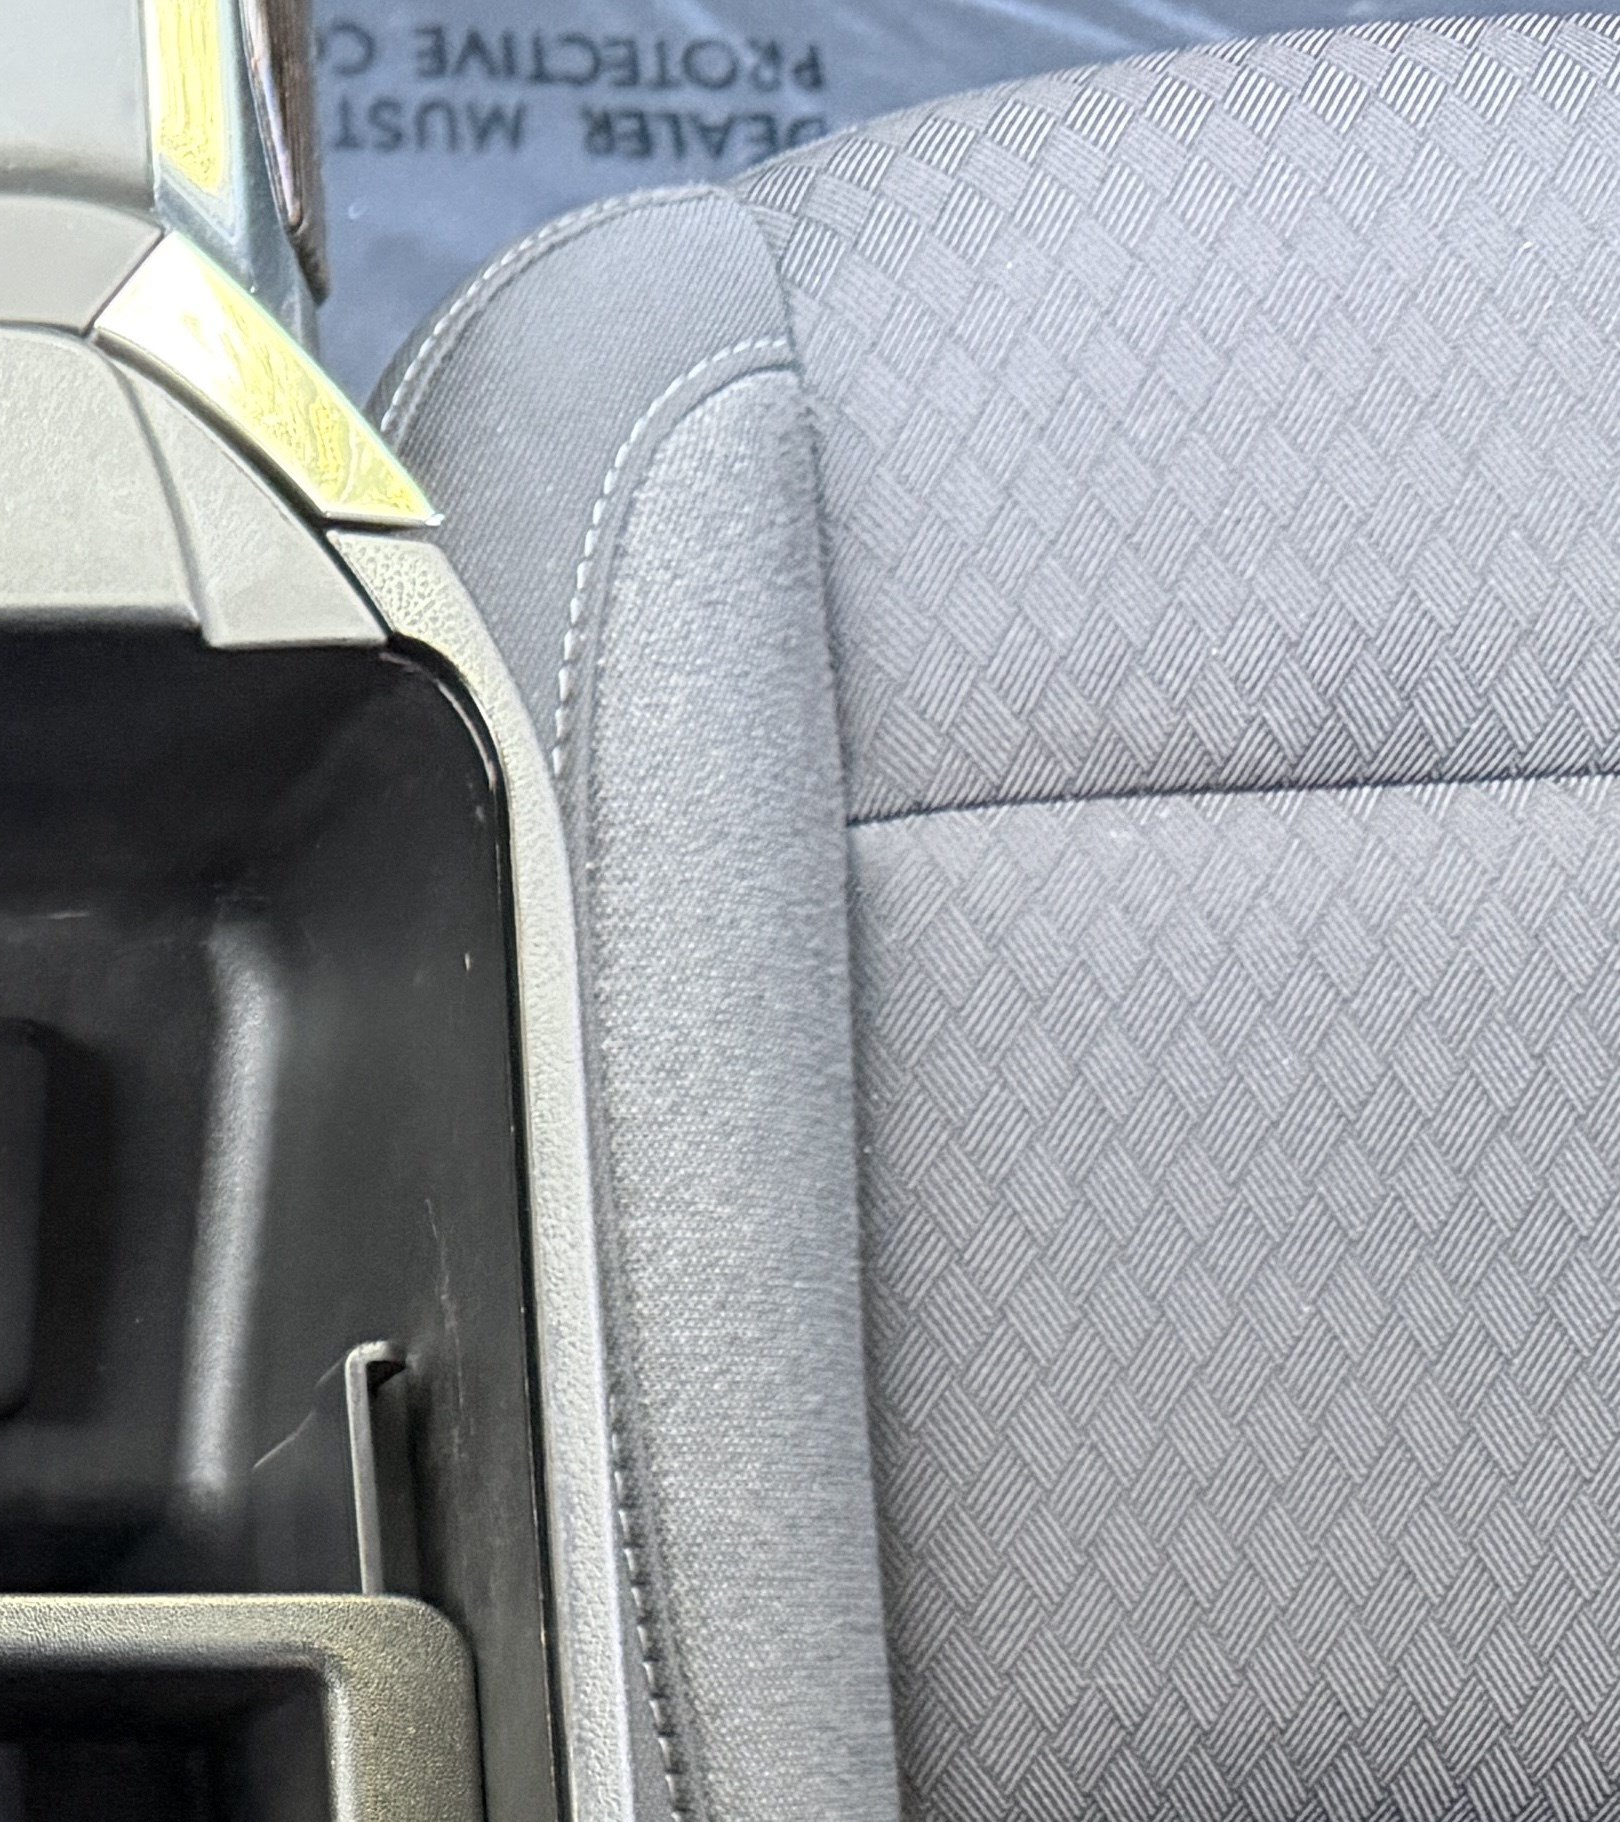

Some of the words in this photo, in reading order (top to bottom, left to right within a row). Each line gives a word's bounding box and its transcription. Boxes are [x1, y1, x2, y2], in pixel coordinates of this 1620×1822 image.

[314, 19, 376, 76] C
[413, 24, 825, 91] PROTECTIVE
[333, 96, 527, 152] MUST
